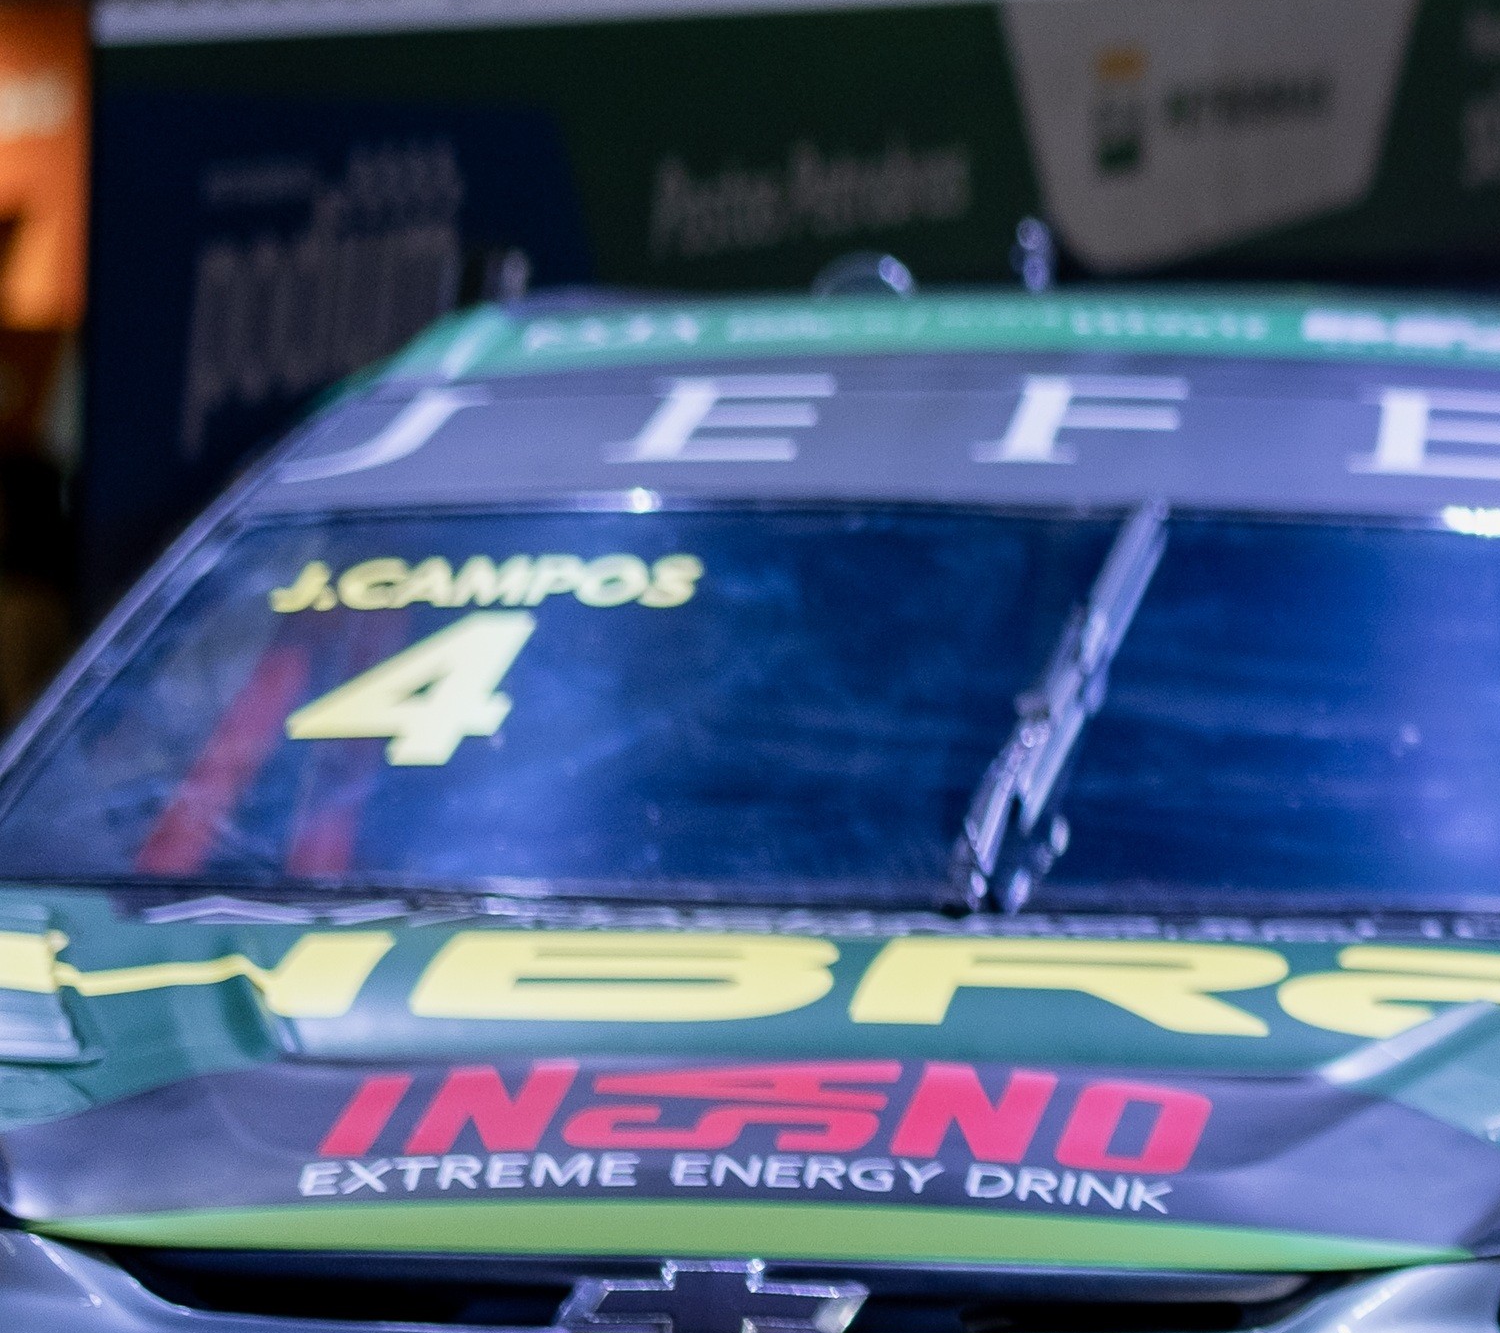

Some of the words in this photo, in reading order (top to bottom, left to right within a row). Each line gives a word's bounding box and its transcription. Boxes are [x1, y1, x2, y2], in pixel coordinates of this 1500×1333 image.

[269, 552, 704, 614] J.CAMPOS
[284, 610, 538, 767] 4
[298, 1152, 640, 1198] EXTREME
[668, 1153, 946, 1195] ENERGY
[964, 1161, 1175, 1214] DRINK
